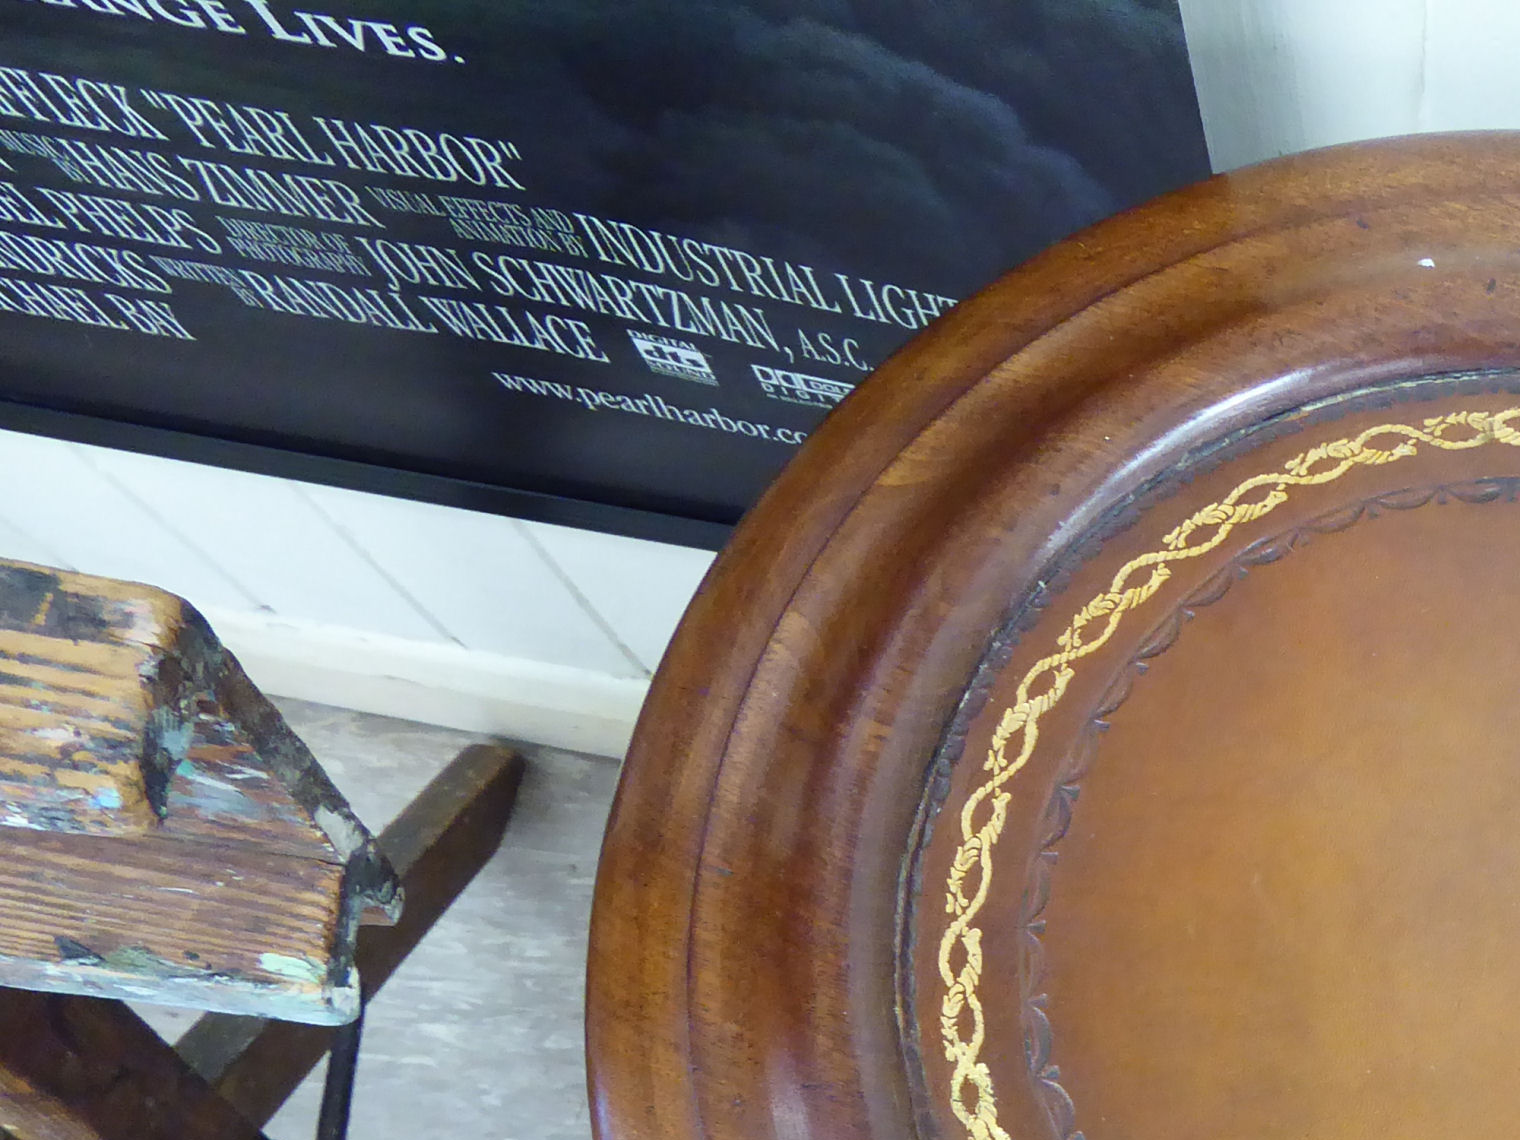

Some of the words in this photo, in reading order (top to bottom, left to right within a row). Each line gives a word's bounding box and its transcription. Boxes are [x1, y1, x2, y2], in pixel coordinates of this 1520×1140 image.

[246, 0, 466, 64] LIVES.
[140, 88, 337, 166] "PEARL
[311, 116, 527, 190] HARBOR"
[54, 137, 200, 201] HANS
[175, 153, 387, 229] ZIMMER
[364, 185, 447, 217] VISUAL
[437, 195, 532, 227] EFFECTS
[530, 207, 575, 234] AND
[33, 186, 223, 255] PHELPS
[214, 215, 328, 252] DIRECTOR
[320, 231, 352, 254] OF
[449, 218, 564, 252] ANIMATION
[557, 231, 589, 258] BY
[0, 231, 173, 294] NDRICKS
[148, 255, 248, 288] WRITTEN
[225, 235, 372, 277] PHOTOGRAPHY
[572, 212, 843, 314] INDUSTRIAL
[0, 276, 131, 331] CHAEL
[103, 292, 198, 342] BAY
[237, 268, 440, 334] RANDALL
[417, 295, 611, 364] WALLACE
[353, 236, 483, 292] JOHN
[798, 328, 875, 372] A.S.C.
